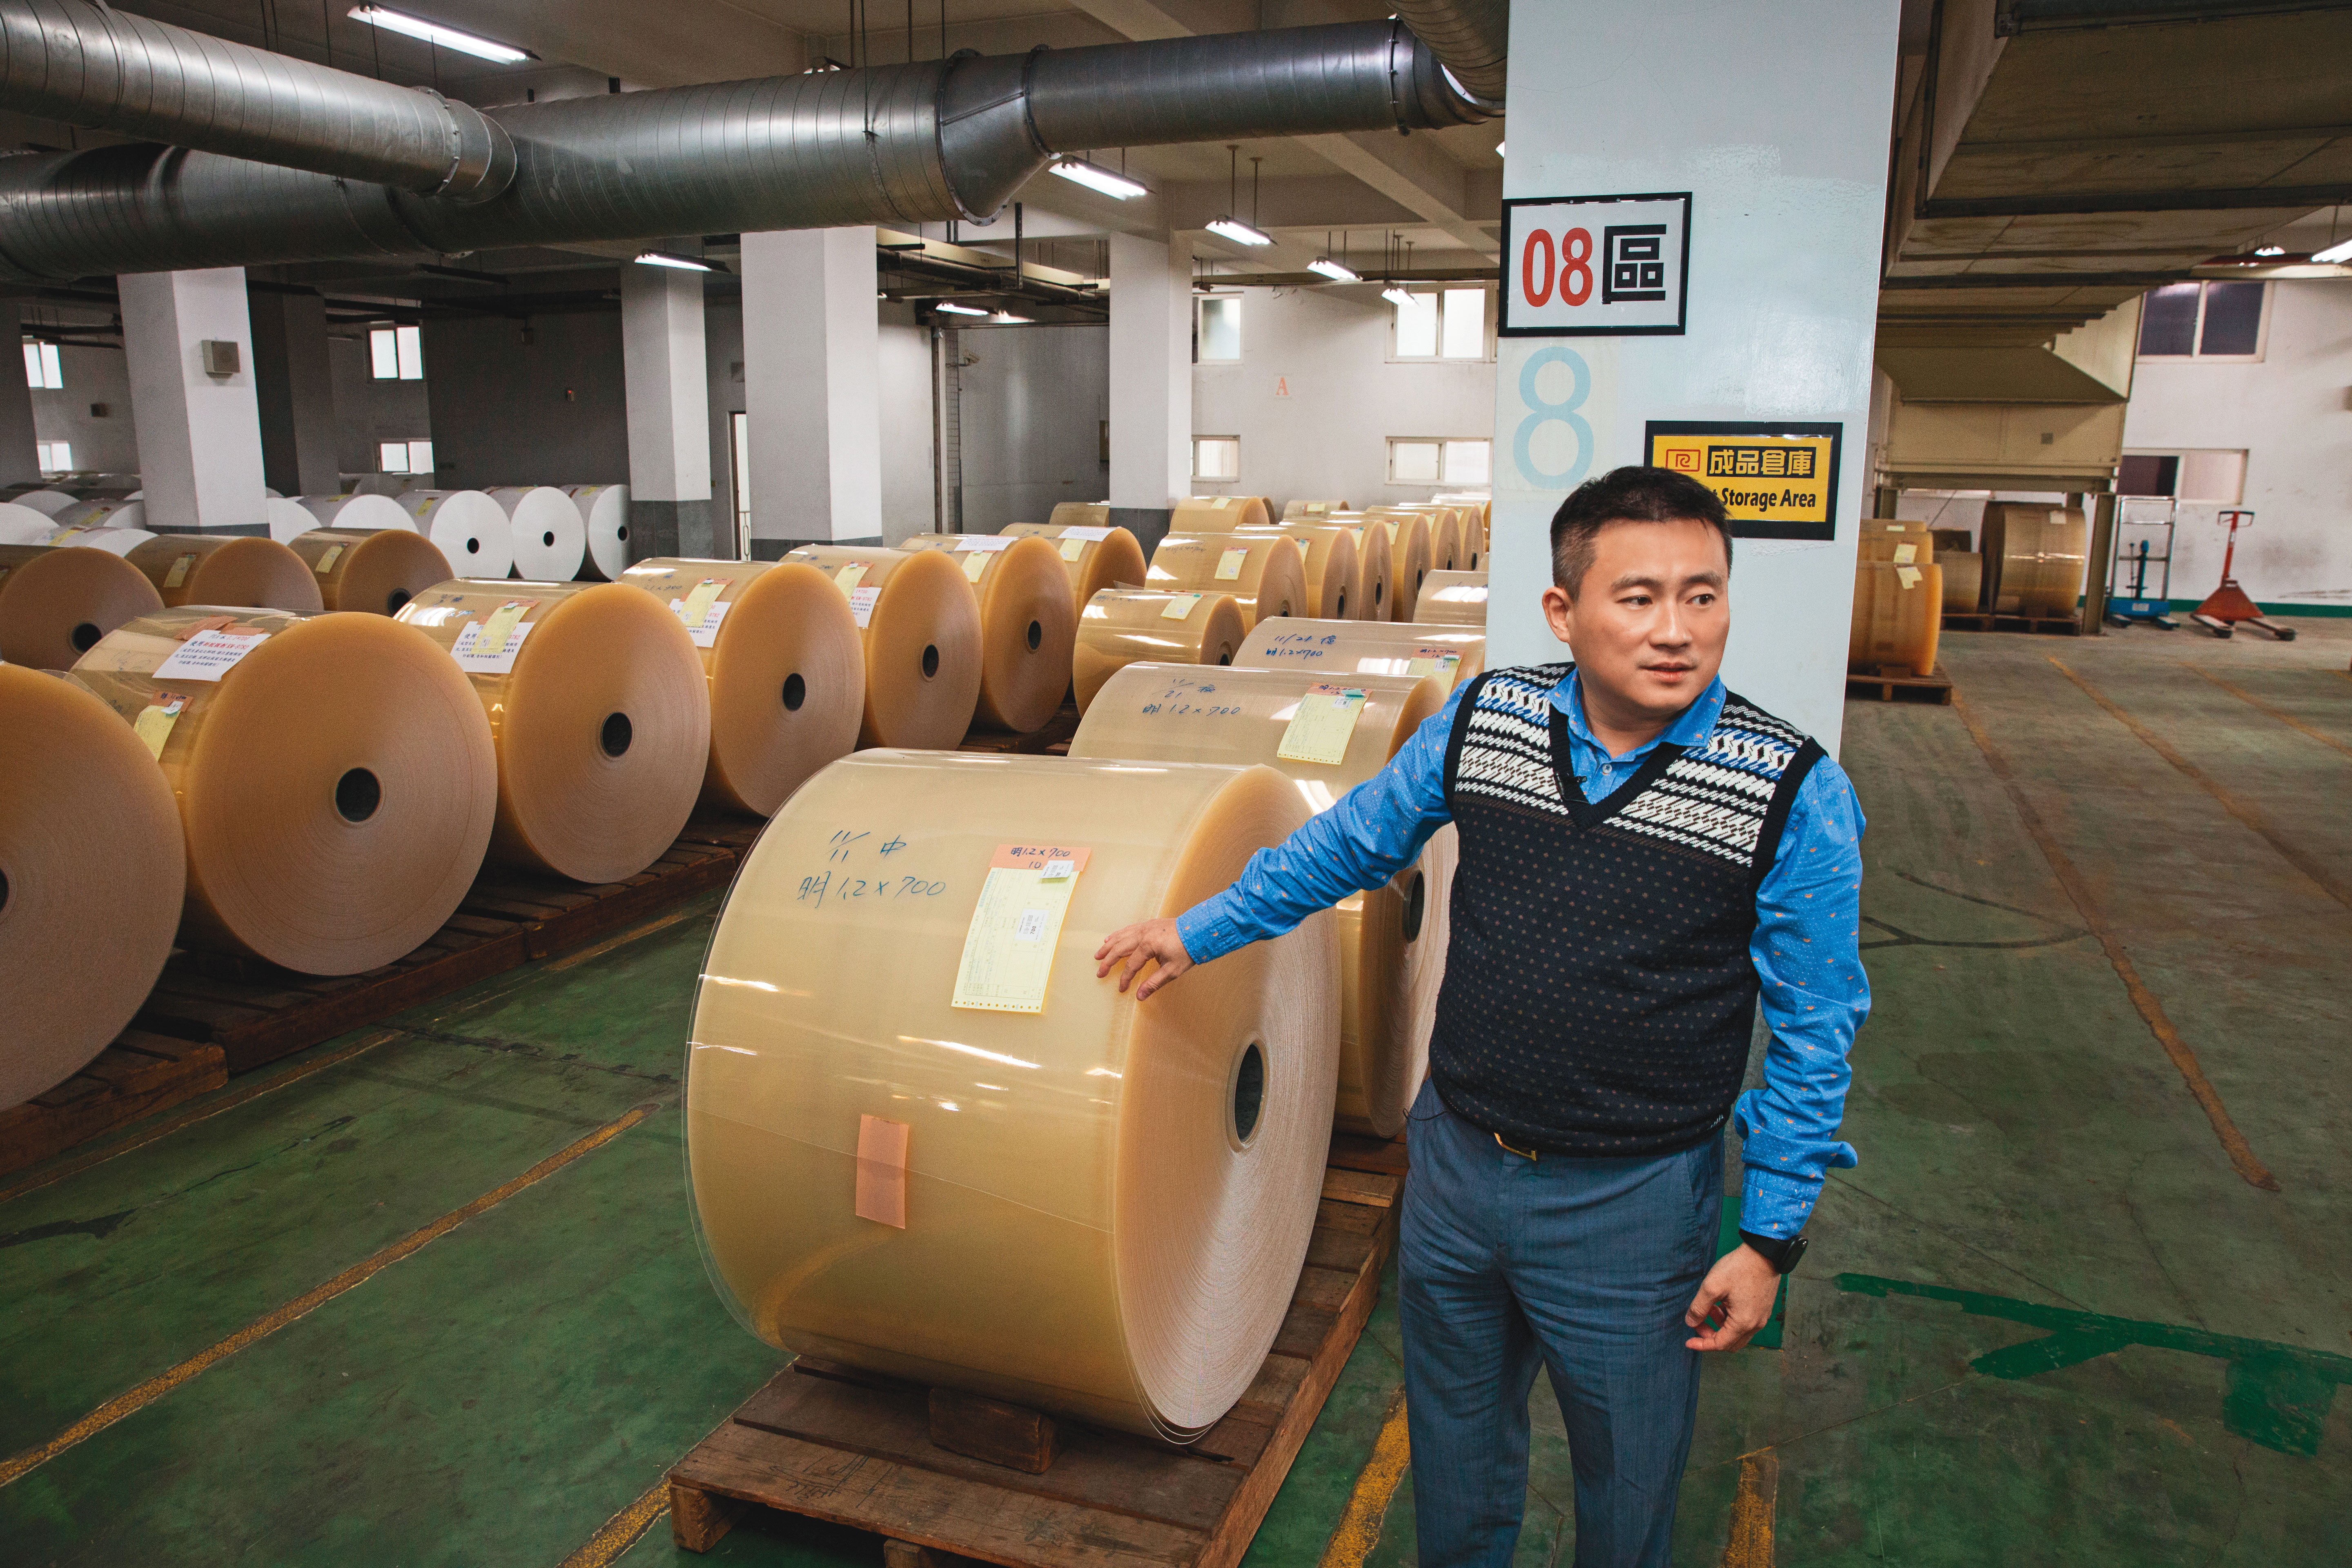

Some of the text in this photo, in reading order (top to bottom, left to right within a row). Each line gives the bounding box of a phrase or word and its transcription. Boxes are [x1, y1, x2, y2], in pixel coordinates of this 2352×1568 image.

[1276, 376, 1289, 396] A
[1512, 346, 1594, 490] 8
[1709, 449, 1813, 476] 成品倉庫
[1722, 488, 1777, 512] Storage
[1780, 489, 1816, 508] Area
[1206, 706, 1240, 716] 700
[1048, 848, 1071, 858] 700
[894, 876, 946, 899] 700
